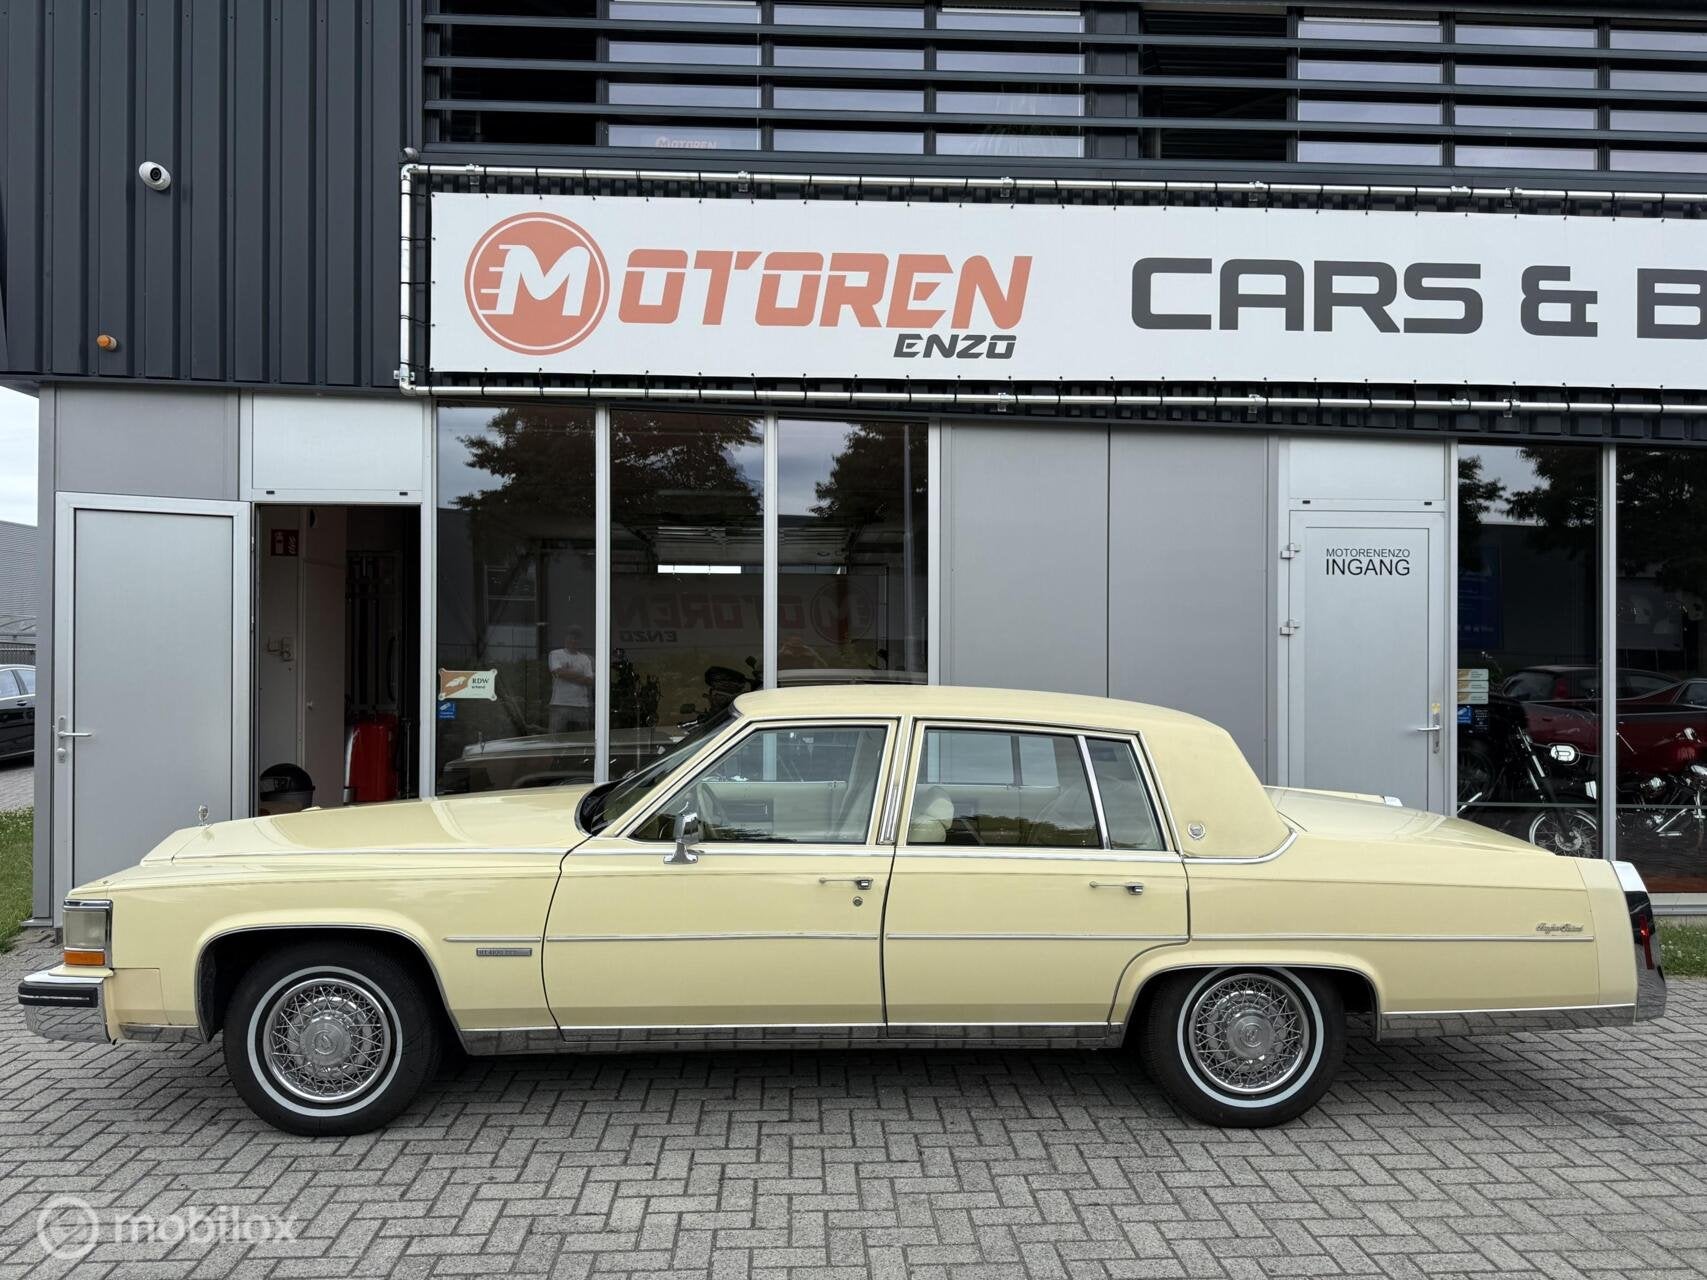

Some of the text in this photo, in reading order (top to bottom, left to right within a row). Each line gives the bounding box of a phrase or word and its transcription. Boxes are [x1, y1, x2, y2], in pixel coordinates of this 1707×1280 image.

[480, 243, 1033, 331] MOTOREN
[1131, 257, 1484, 335] CARS
[1520, 265, 1599, 338] &
[893, 333, 1017, 360] ENZO
[1325, 548, 1411, 558] MOTORENENZO
[1325, 558, 1411, 576] INGANG
